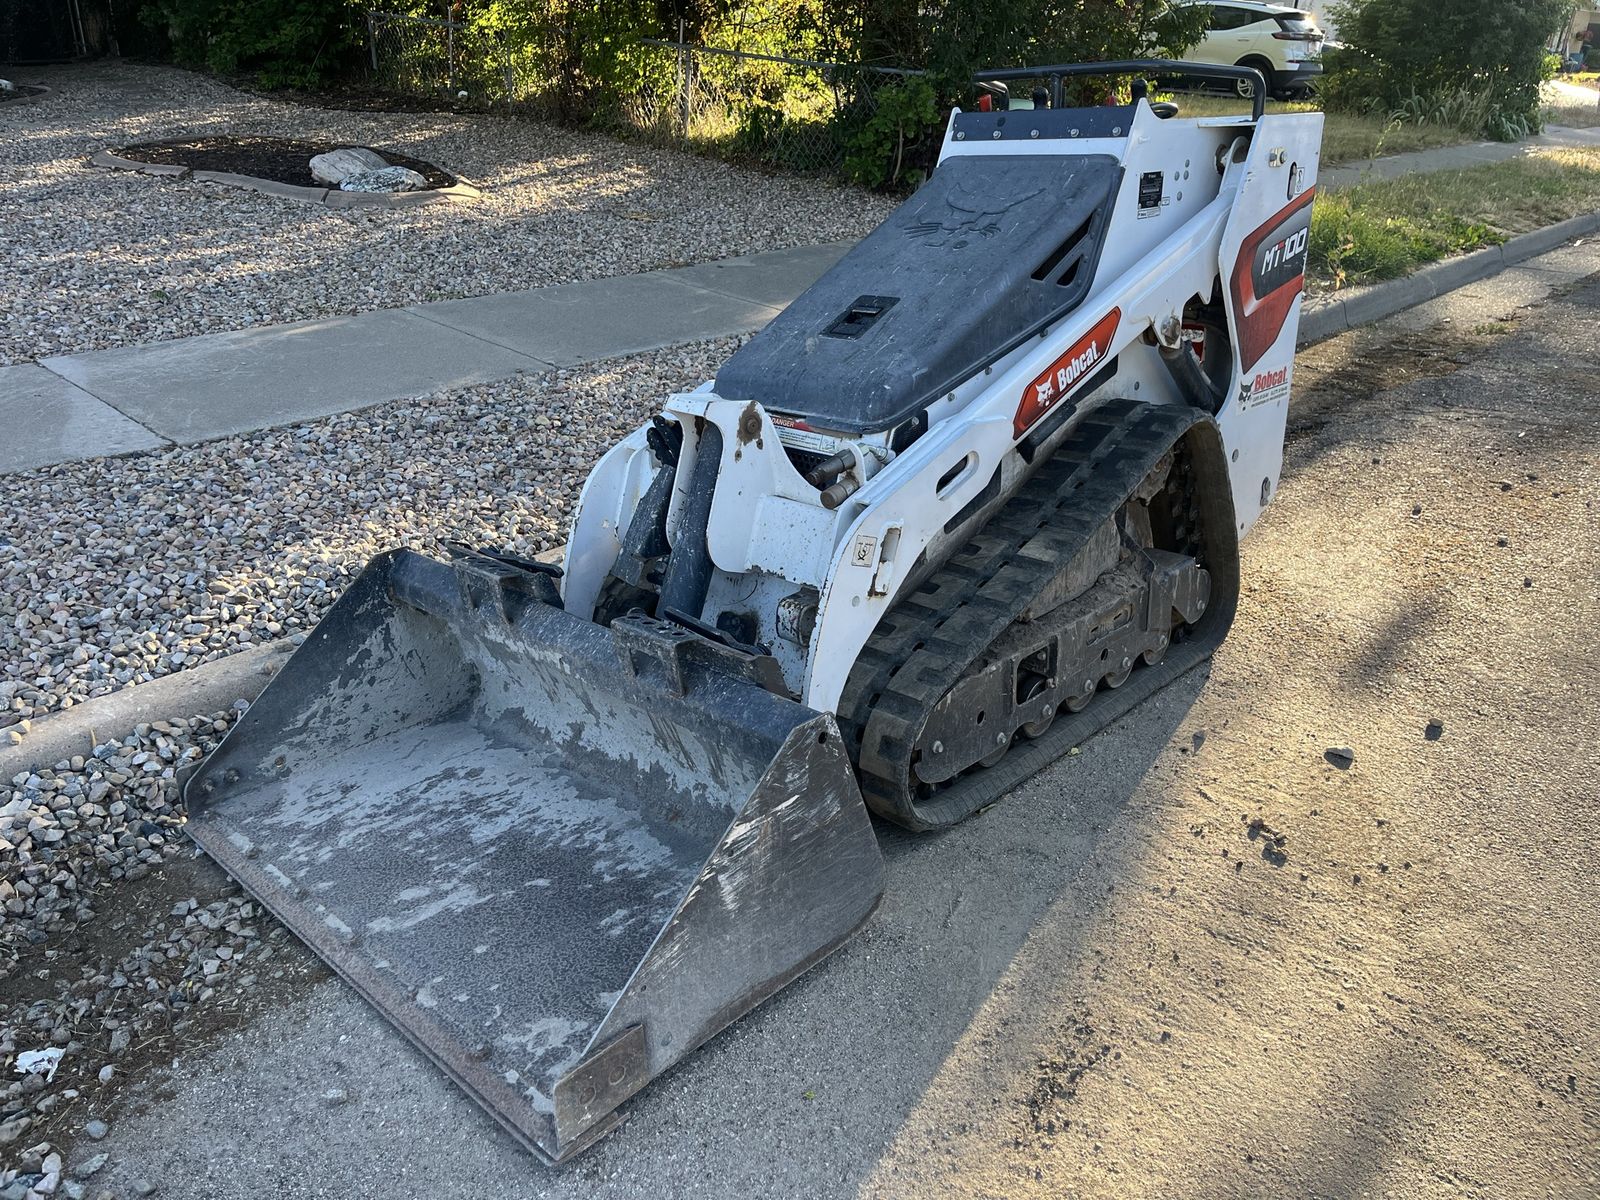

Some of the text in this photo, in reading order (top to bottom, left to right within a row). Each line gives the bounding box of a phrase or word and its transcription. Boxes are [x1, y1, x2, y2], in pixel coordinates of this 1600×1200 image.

[1057, 340, 1099, 392] Bobcat
[1255, 366, 1287, 392] Bobcat
[771, 417, 795, 428] DANGER
